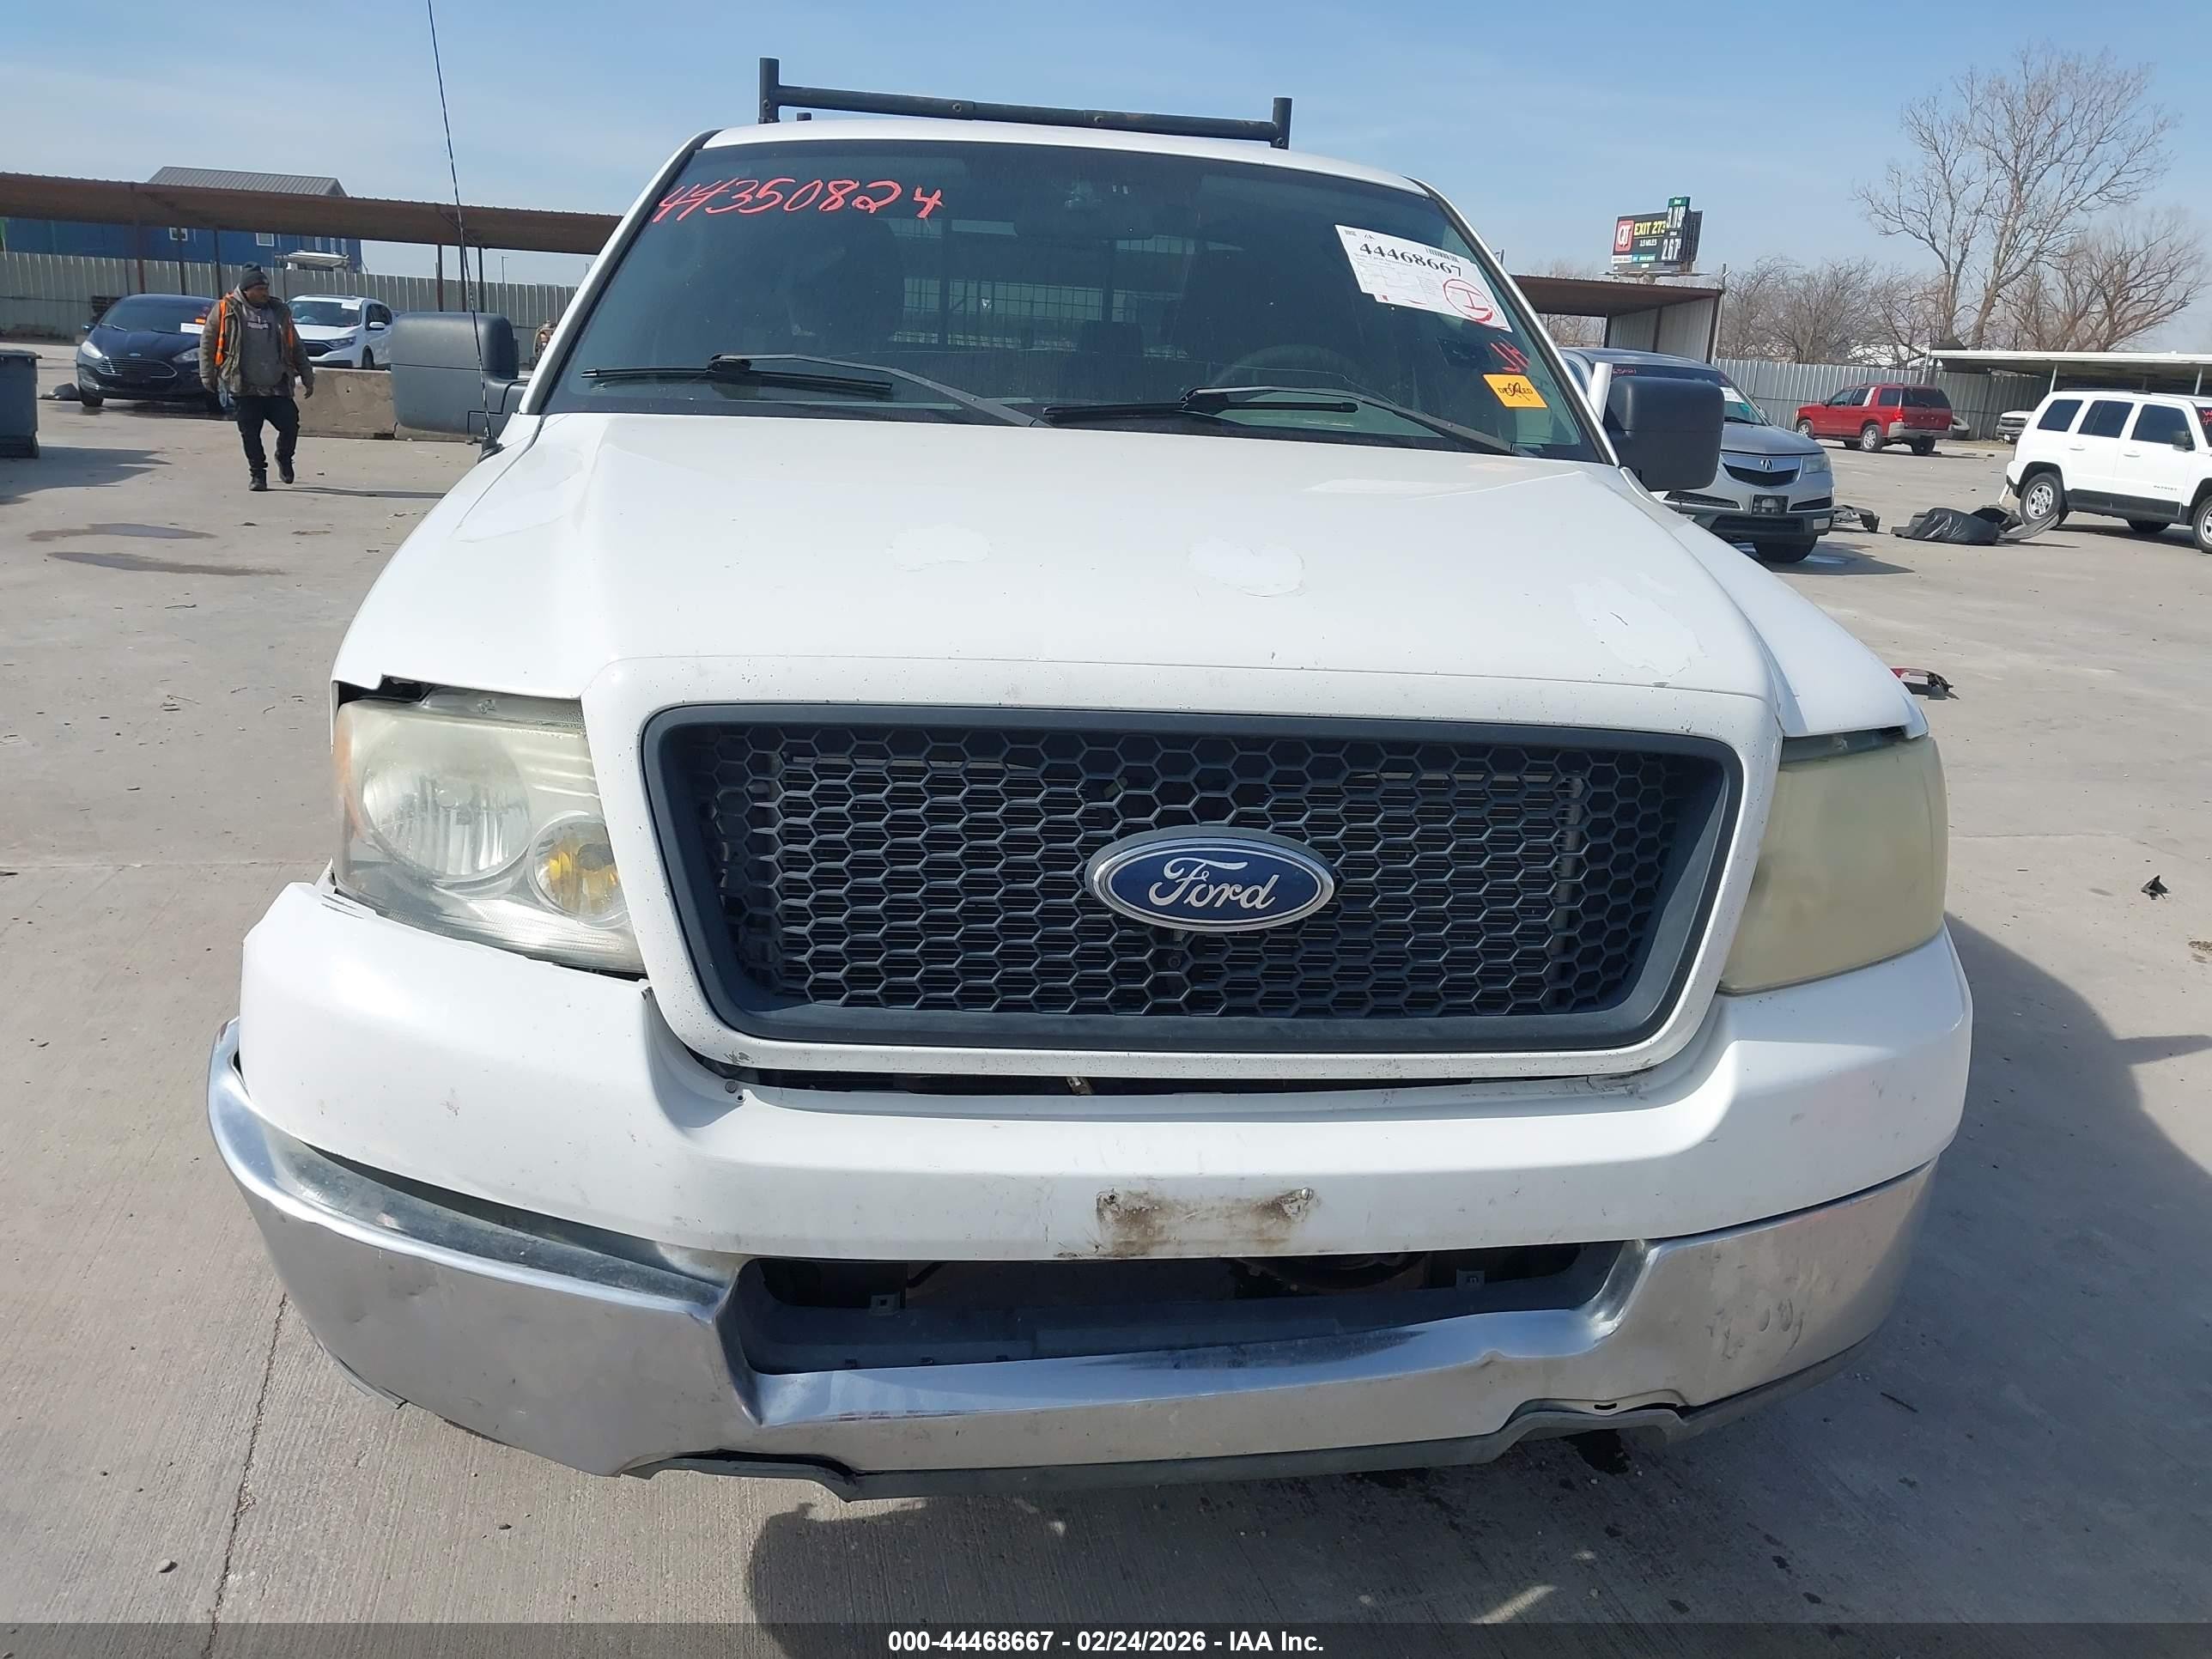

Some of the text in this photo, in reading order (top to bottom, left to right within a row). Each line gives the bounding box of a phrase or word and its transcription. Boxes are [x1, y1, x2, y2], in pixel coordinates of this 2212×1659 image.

[1634, 222, 1651, 236] EXIT
[1359, 243, 1462, 276] 44468667
[1149, 857, 1280, 909] Ford
